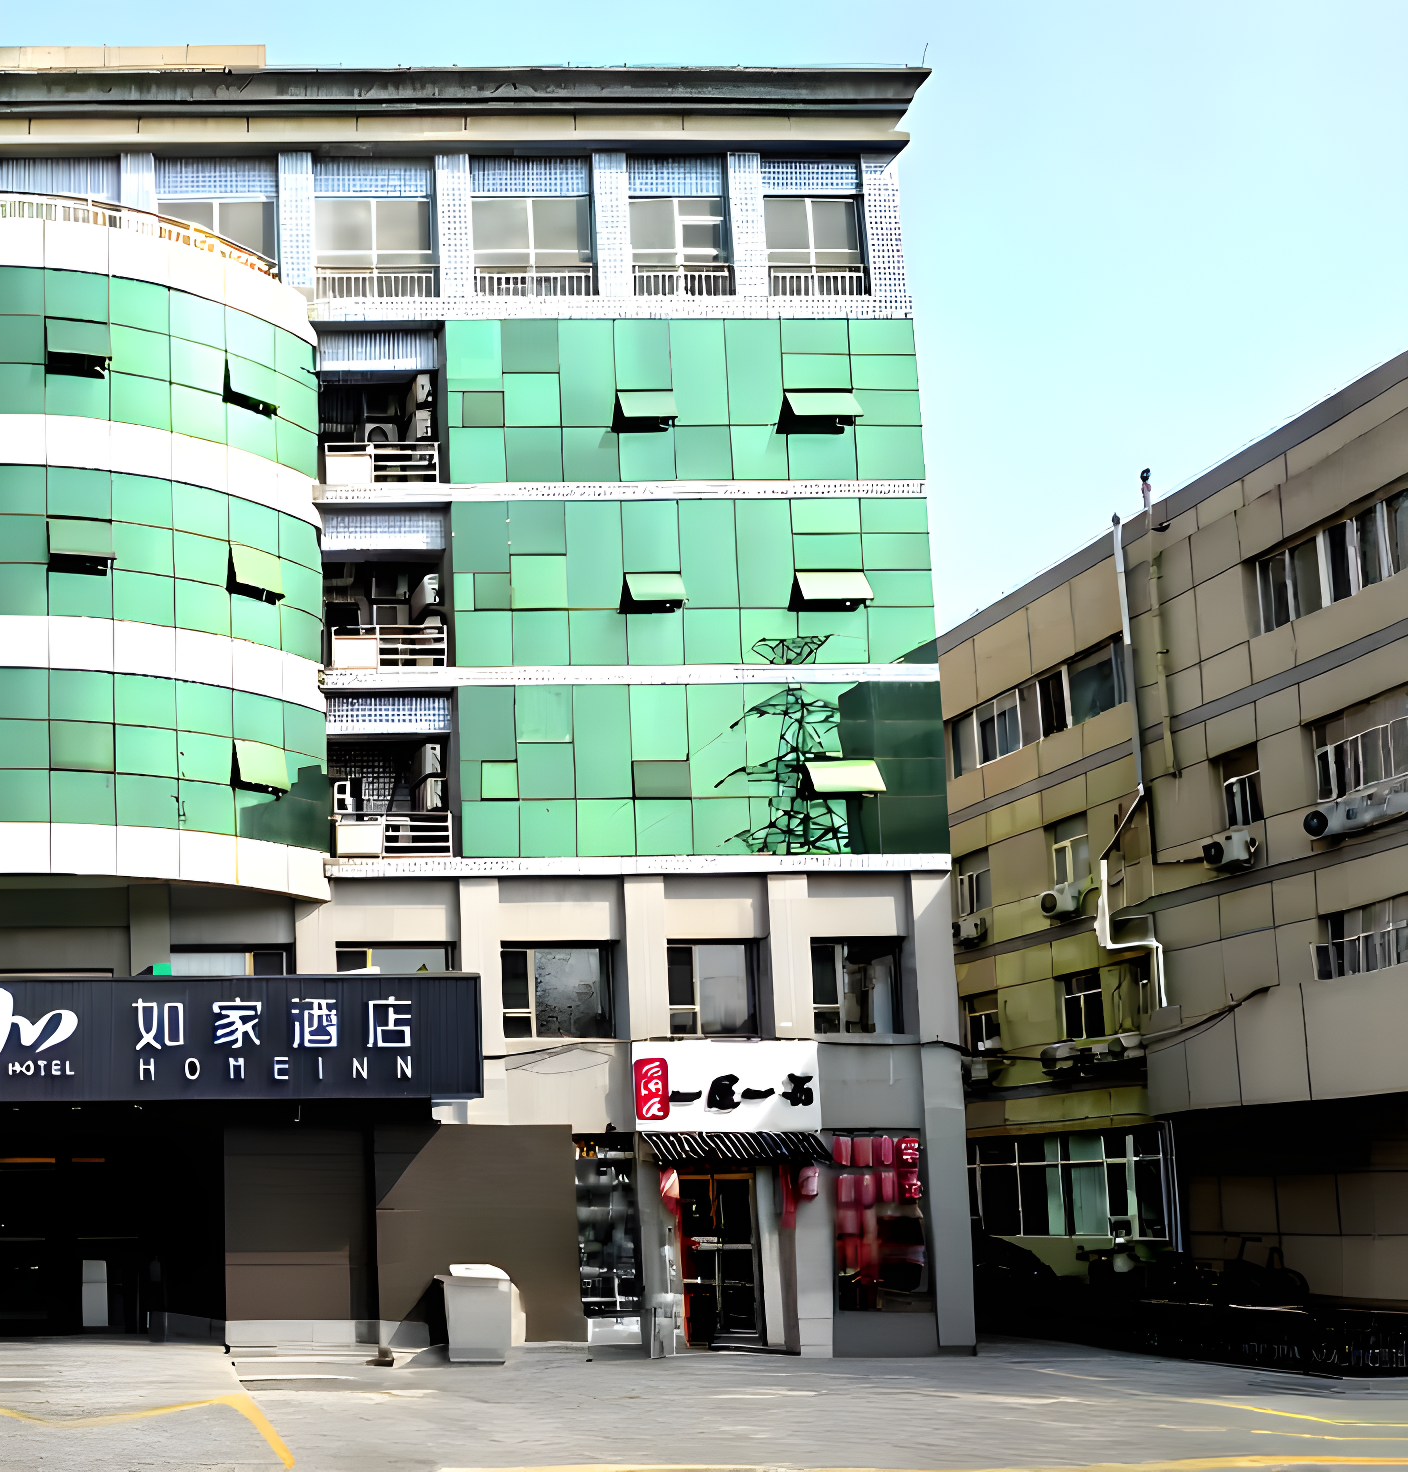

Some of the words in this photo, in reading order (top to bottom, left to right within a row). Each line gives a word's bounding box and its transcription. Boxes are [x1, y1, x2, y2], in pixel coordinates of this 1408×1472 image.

[131, 996, 412, 1050] 如家酒店
[8, 1060, 75, 1076] HOTEL
